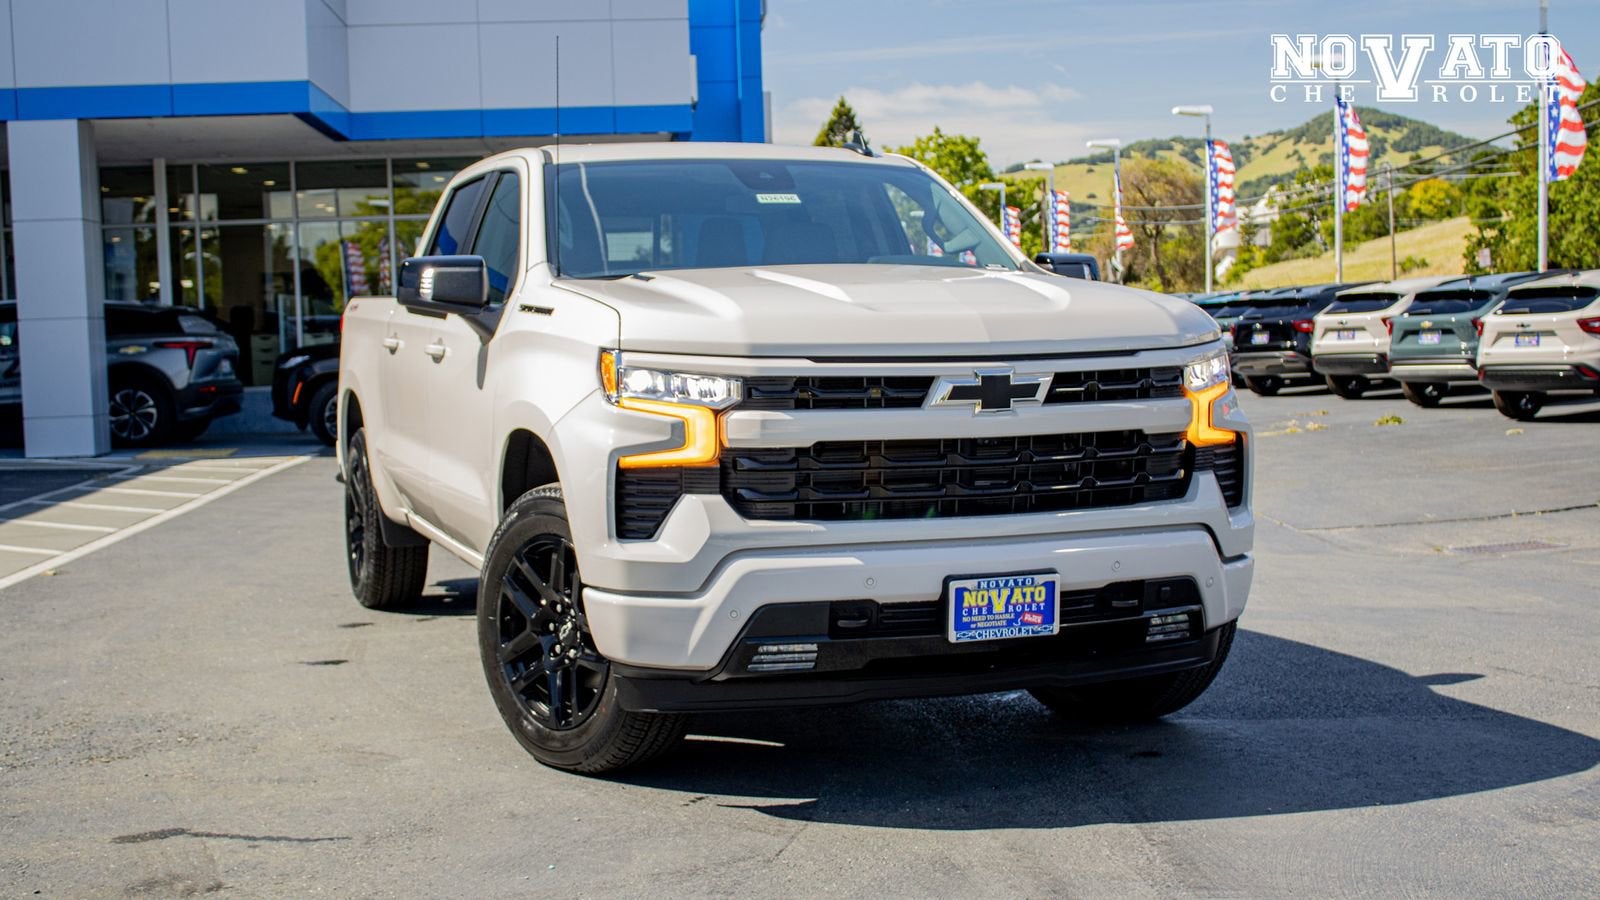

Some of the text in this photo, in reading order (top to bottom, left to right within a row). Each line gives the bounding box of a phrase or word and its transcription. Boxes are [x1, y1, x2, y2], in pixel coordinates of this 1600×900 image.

[980, 577, 1032, 589] NOVATO
[963, 586, 1047, 613] NOVATO
[975, 626, 1033, 640] CHEVROLET
